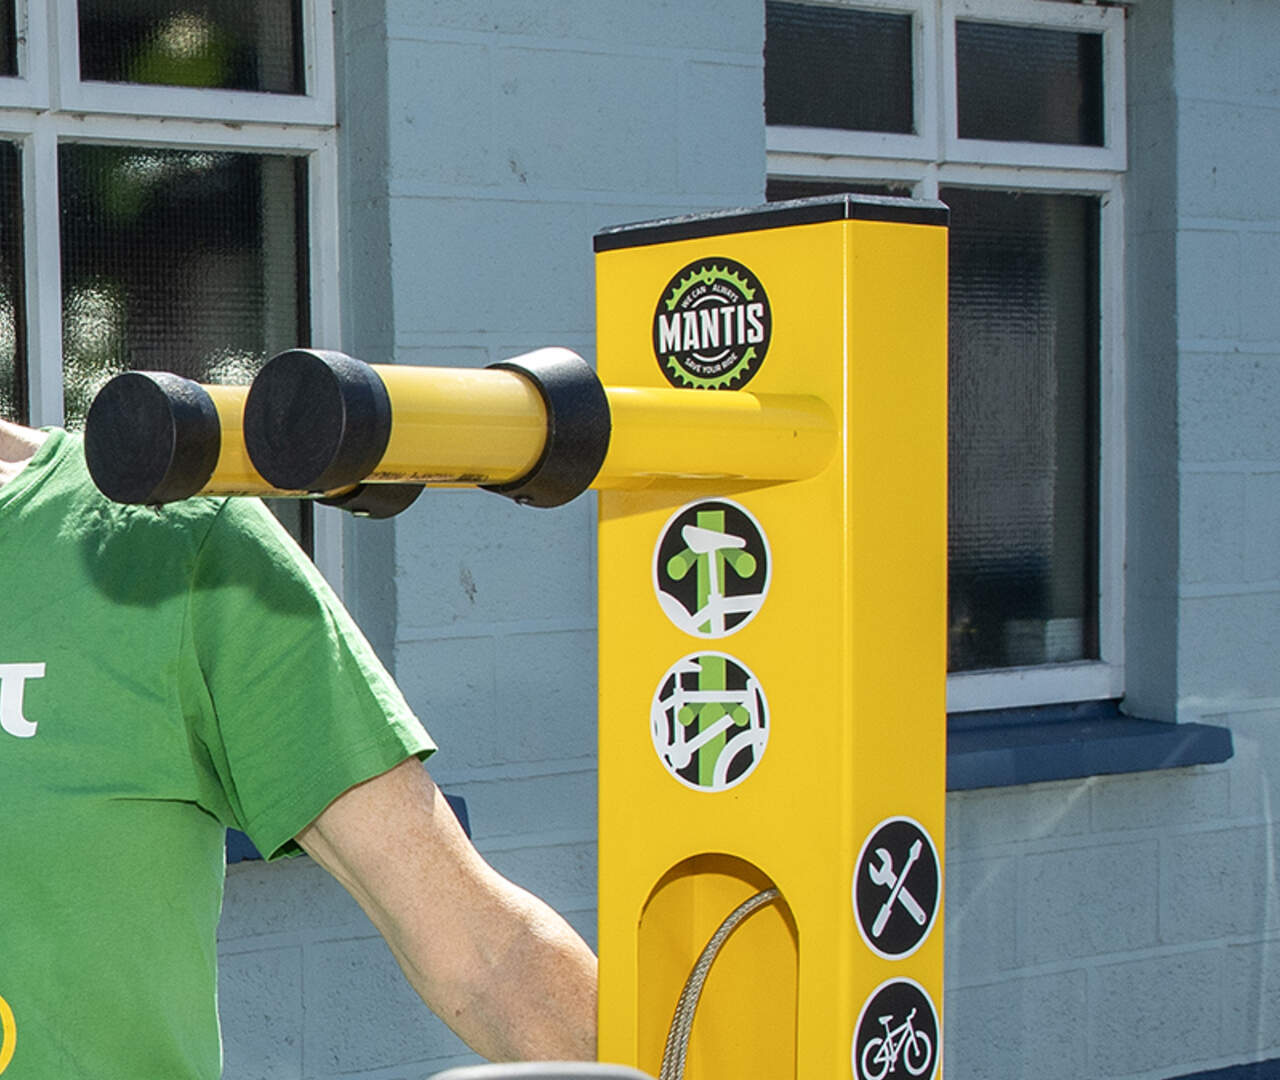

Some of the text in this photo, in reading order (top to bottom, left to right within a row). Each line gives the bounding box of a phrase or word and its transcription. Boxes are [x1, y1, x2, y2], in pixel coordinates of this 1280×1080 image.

[681, 284, 739, 308] WE CAN ALWAYS
[658, 302, 764, 354] MANTIS
[684, 352, 738, 374] SAVE YOUR RIDE
